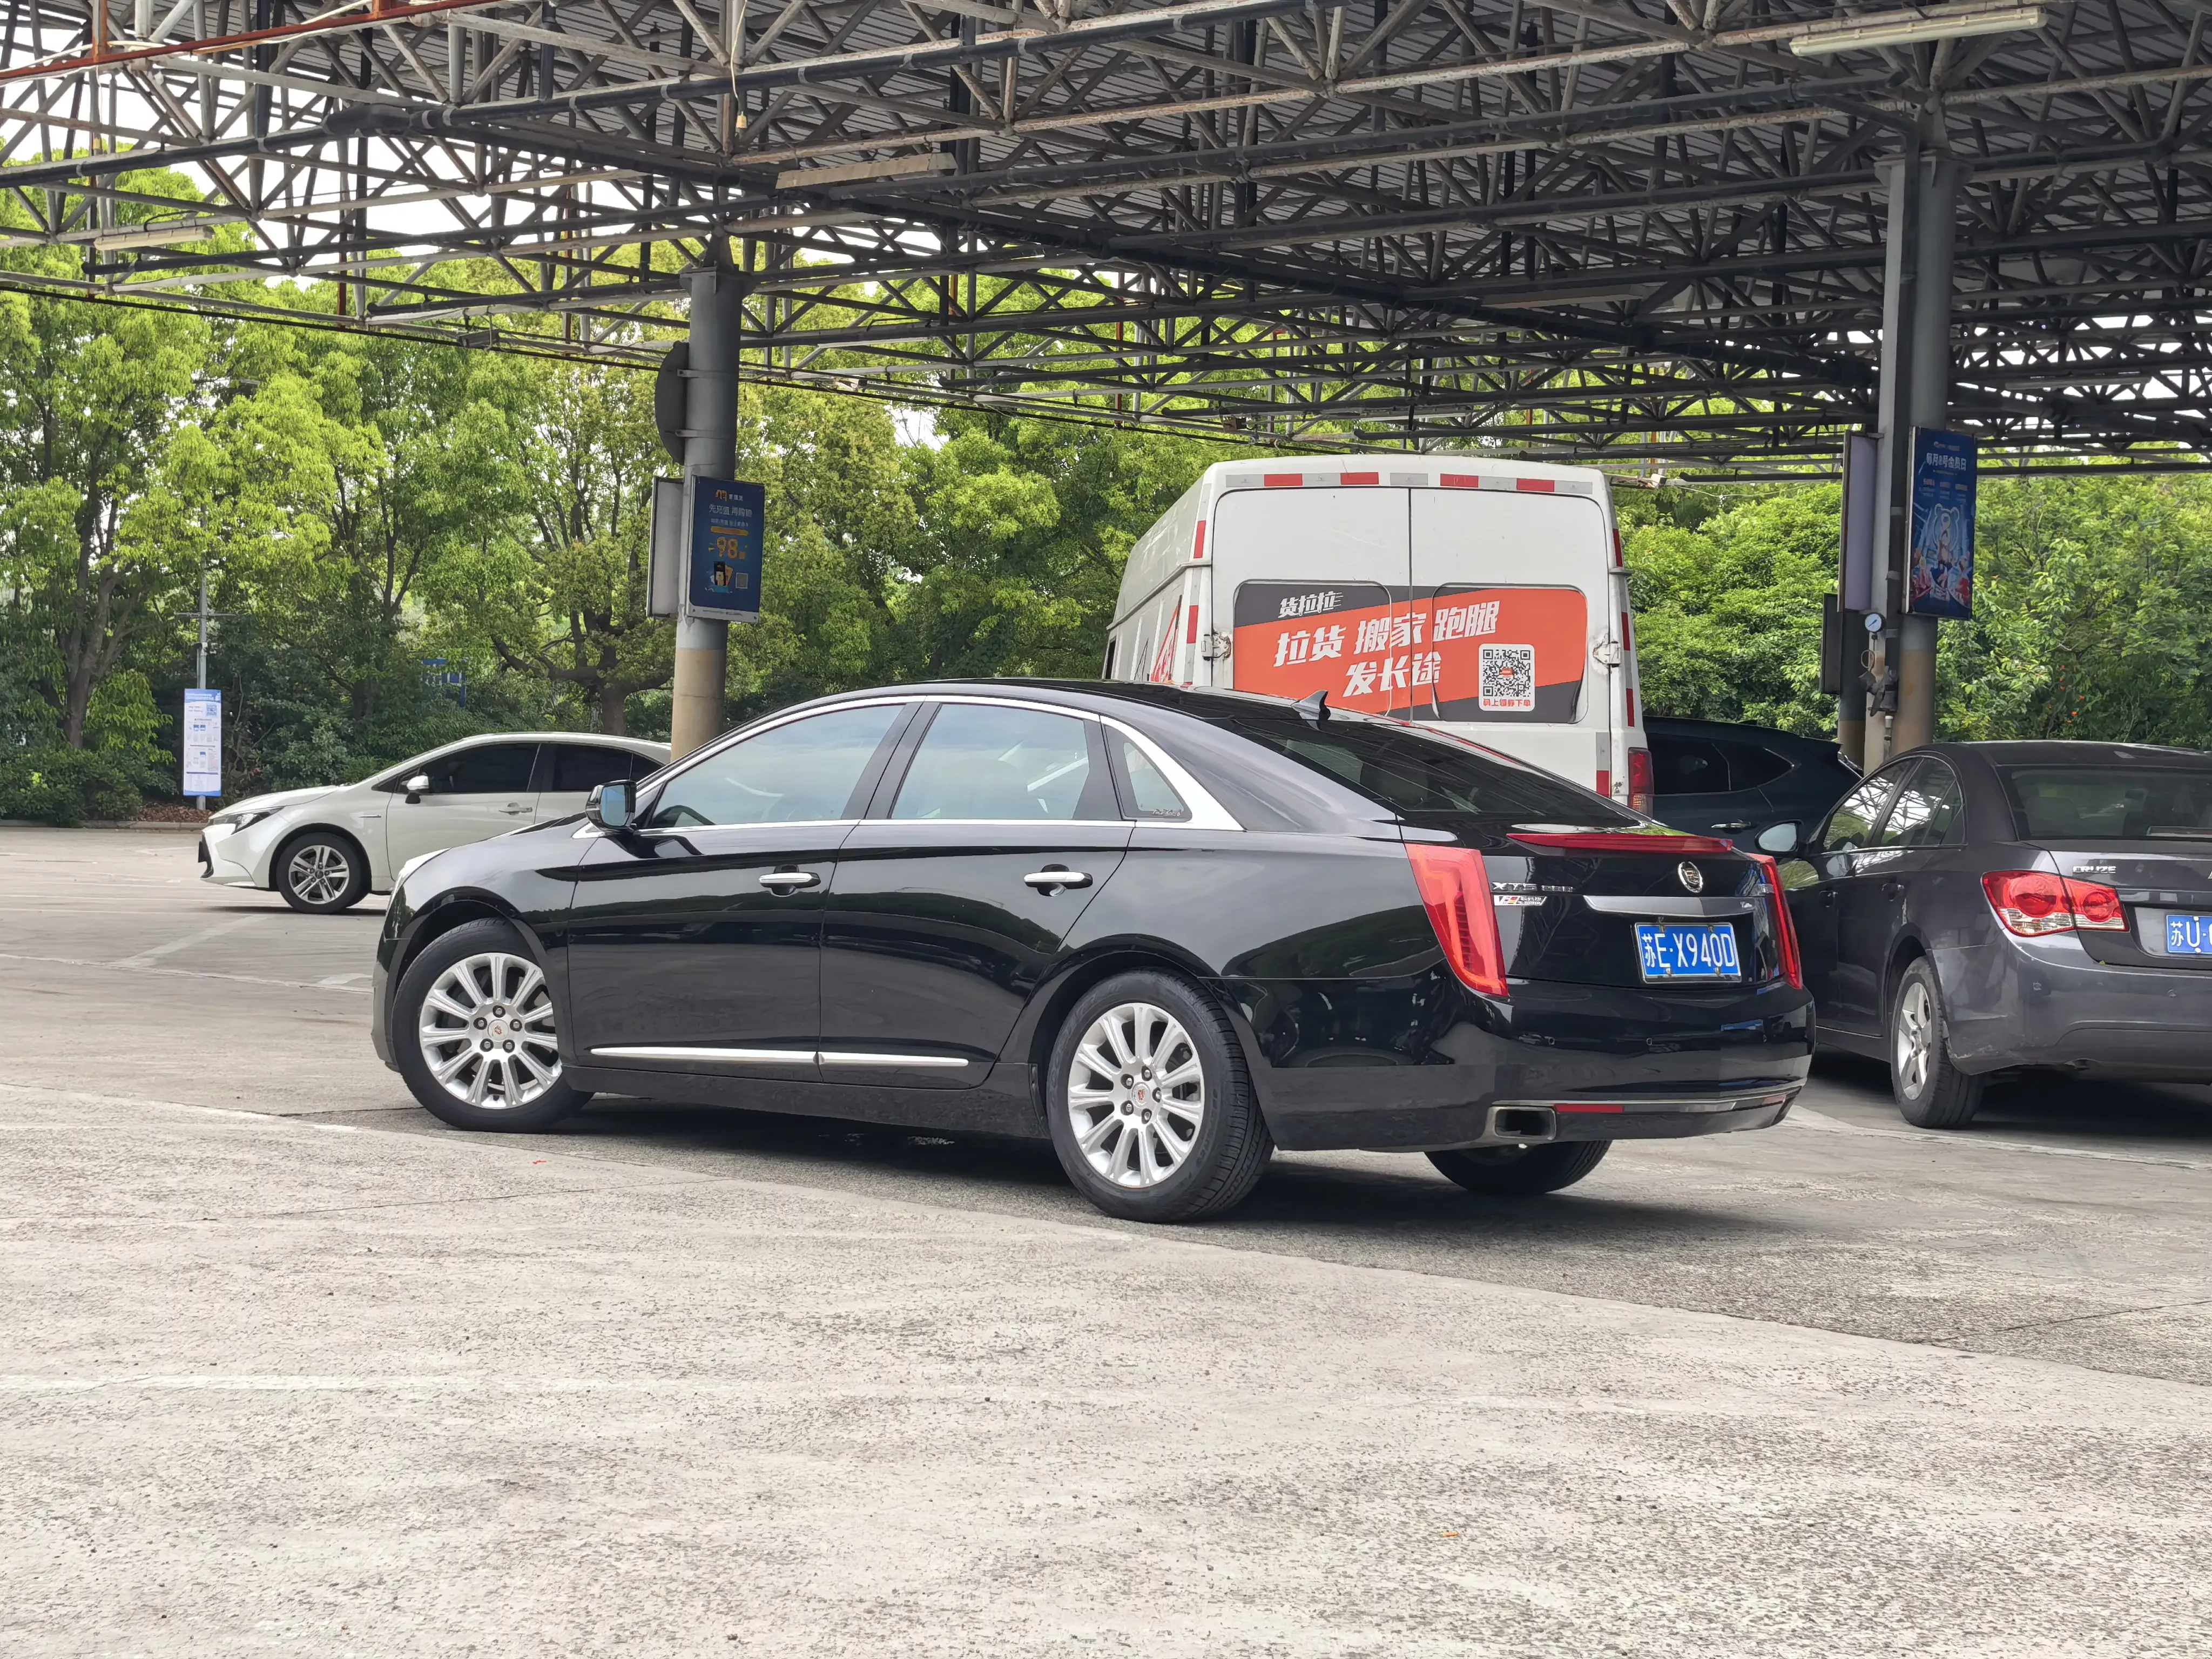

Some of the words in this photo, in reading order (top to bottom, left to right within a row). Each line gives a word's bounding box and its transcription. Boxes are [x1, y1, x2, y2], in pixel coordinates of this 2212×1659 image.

[1278, 591, 1343, 618] 货拉拉
[1273, 625, 1347, 667] 拉货
[1355, 612, 1427, 653] 搬家
[1433, 601, 1500, 642] 跑腿
[1342, 651, 1441, 698] 发长途
